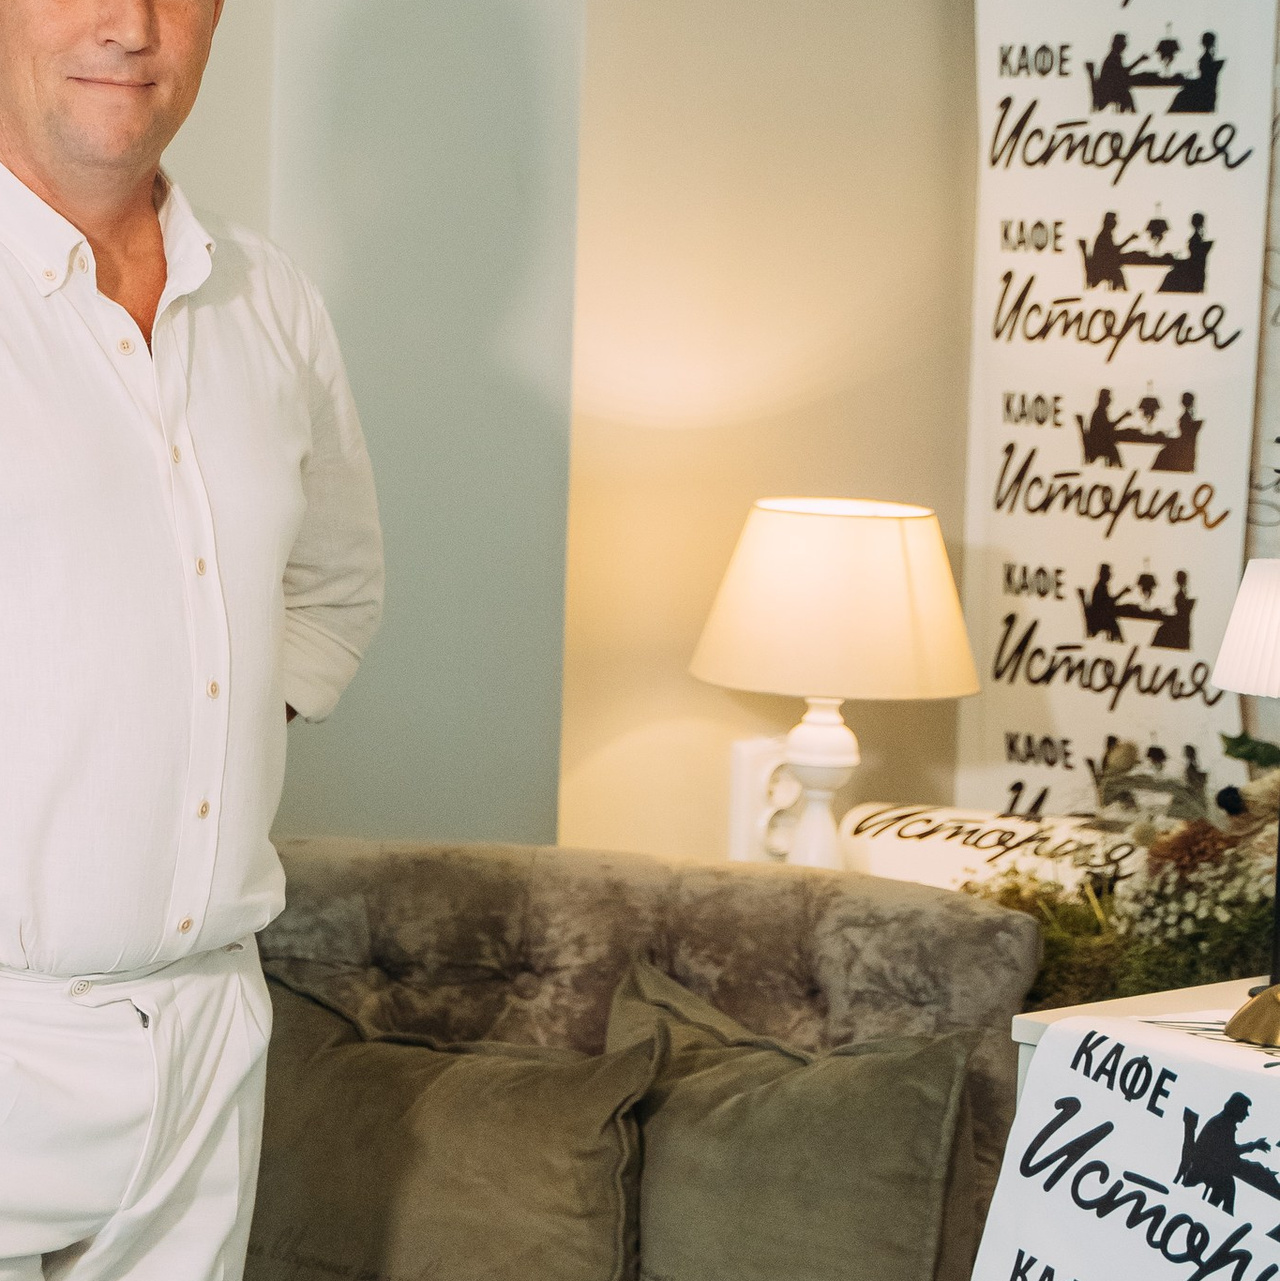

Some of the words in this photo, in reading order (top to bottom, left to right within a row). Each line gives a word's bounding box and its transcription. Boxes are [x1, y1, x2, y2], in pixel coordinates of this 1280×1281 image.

[999, 43, 1071, 79] КАФЕ
[991, 95, 1253, 187] История
[1000, 219, 1065, 254] КАФЕ
[993, 270, 1241, 363] История
[1003, 392, 1064, 428] КАФЕ
[995, 441, 1230, 539] История
[1003, 562, 1067, 601] КАФЕ
[992, 611, 1225, 712] История
[1005, 731, 1075, 772] КАФЕ
[1069, 1029, 1178, 1119] КАФЕ
